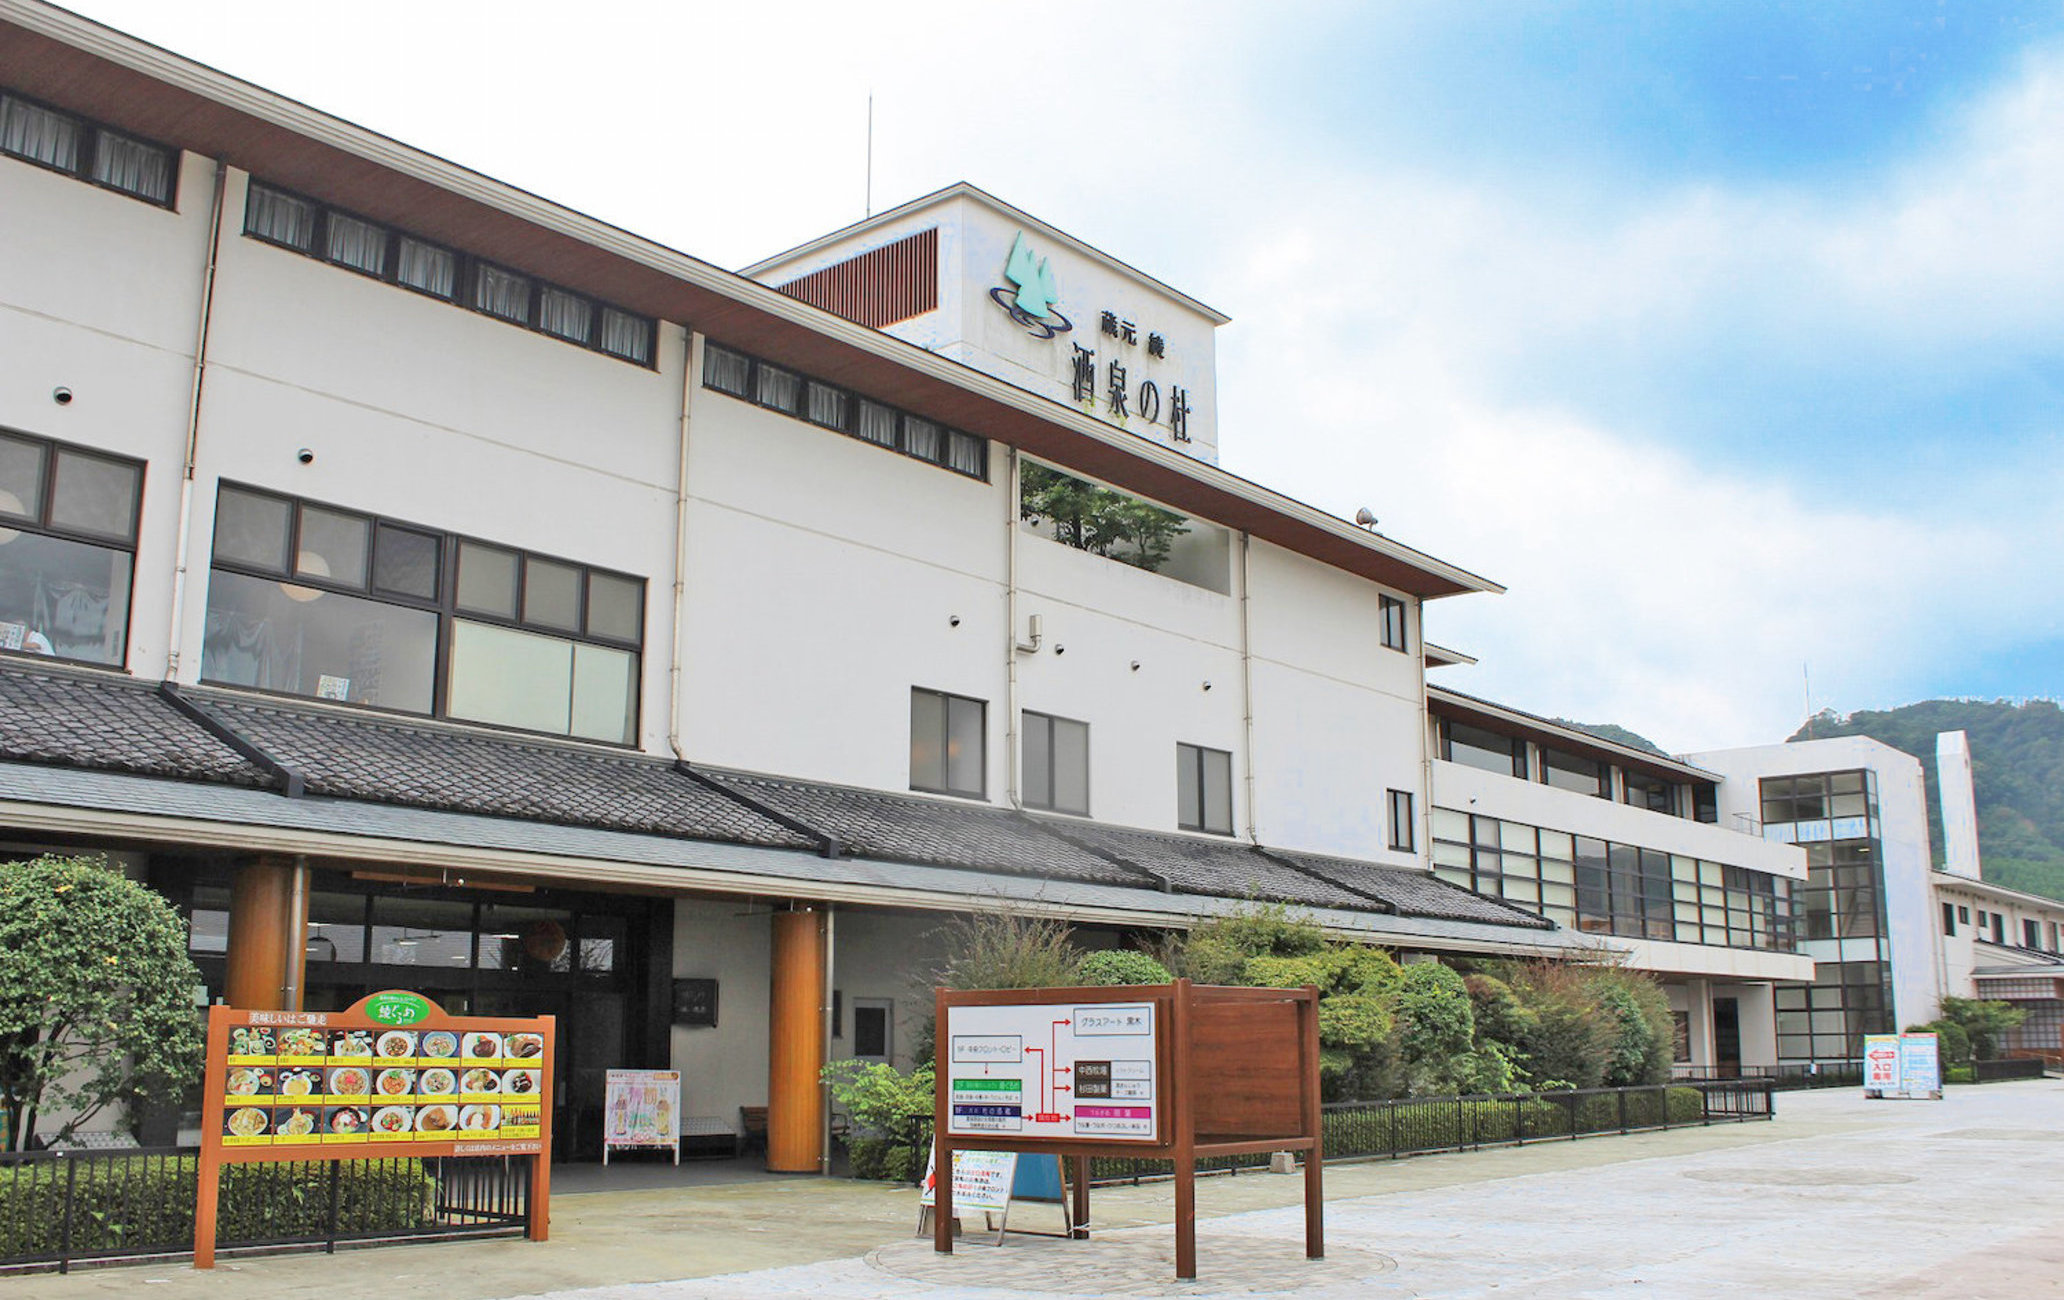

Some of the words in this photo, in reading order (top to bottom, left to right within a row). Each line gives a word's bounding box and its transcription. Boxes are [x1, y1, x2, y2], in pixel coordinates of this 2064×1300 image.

[1071, 341, 1191, 443] 酒泉の杜
[1873, 1063, 1891, 1071] 入口
